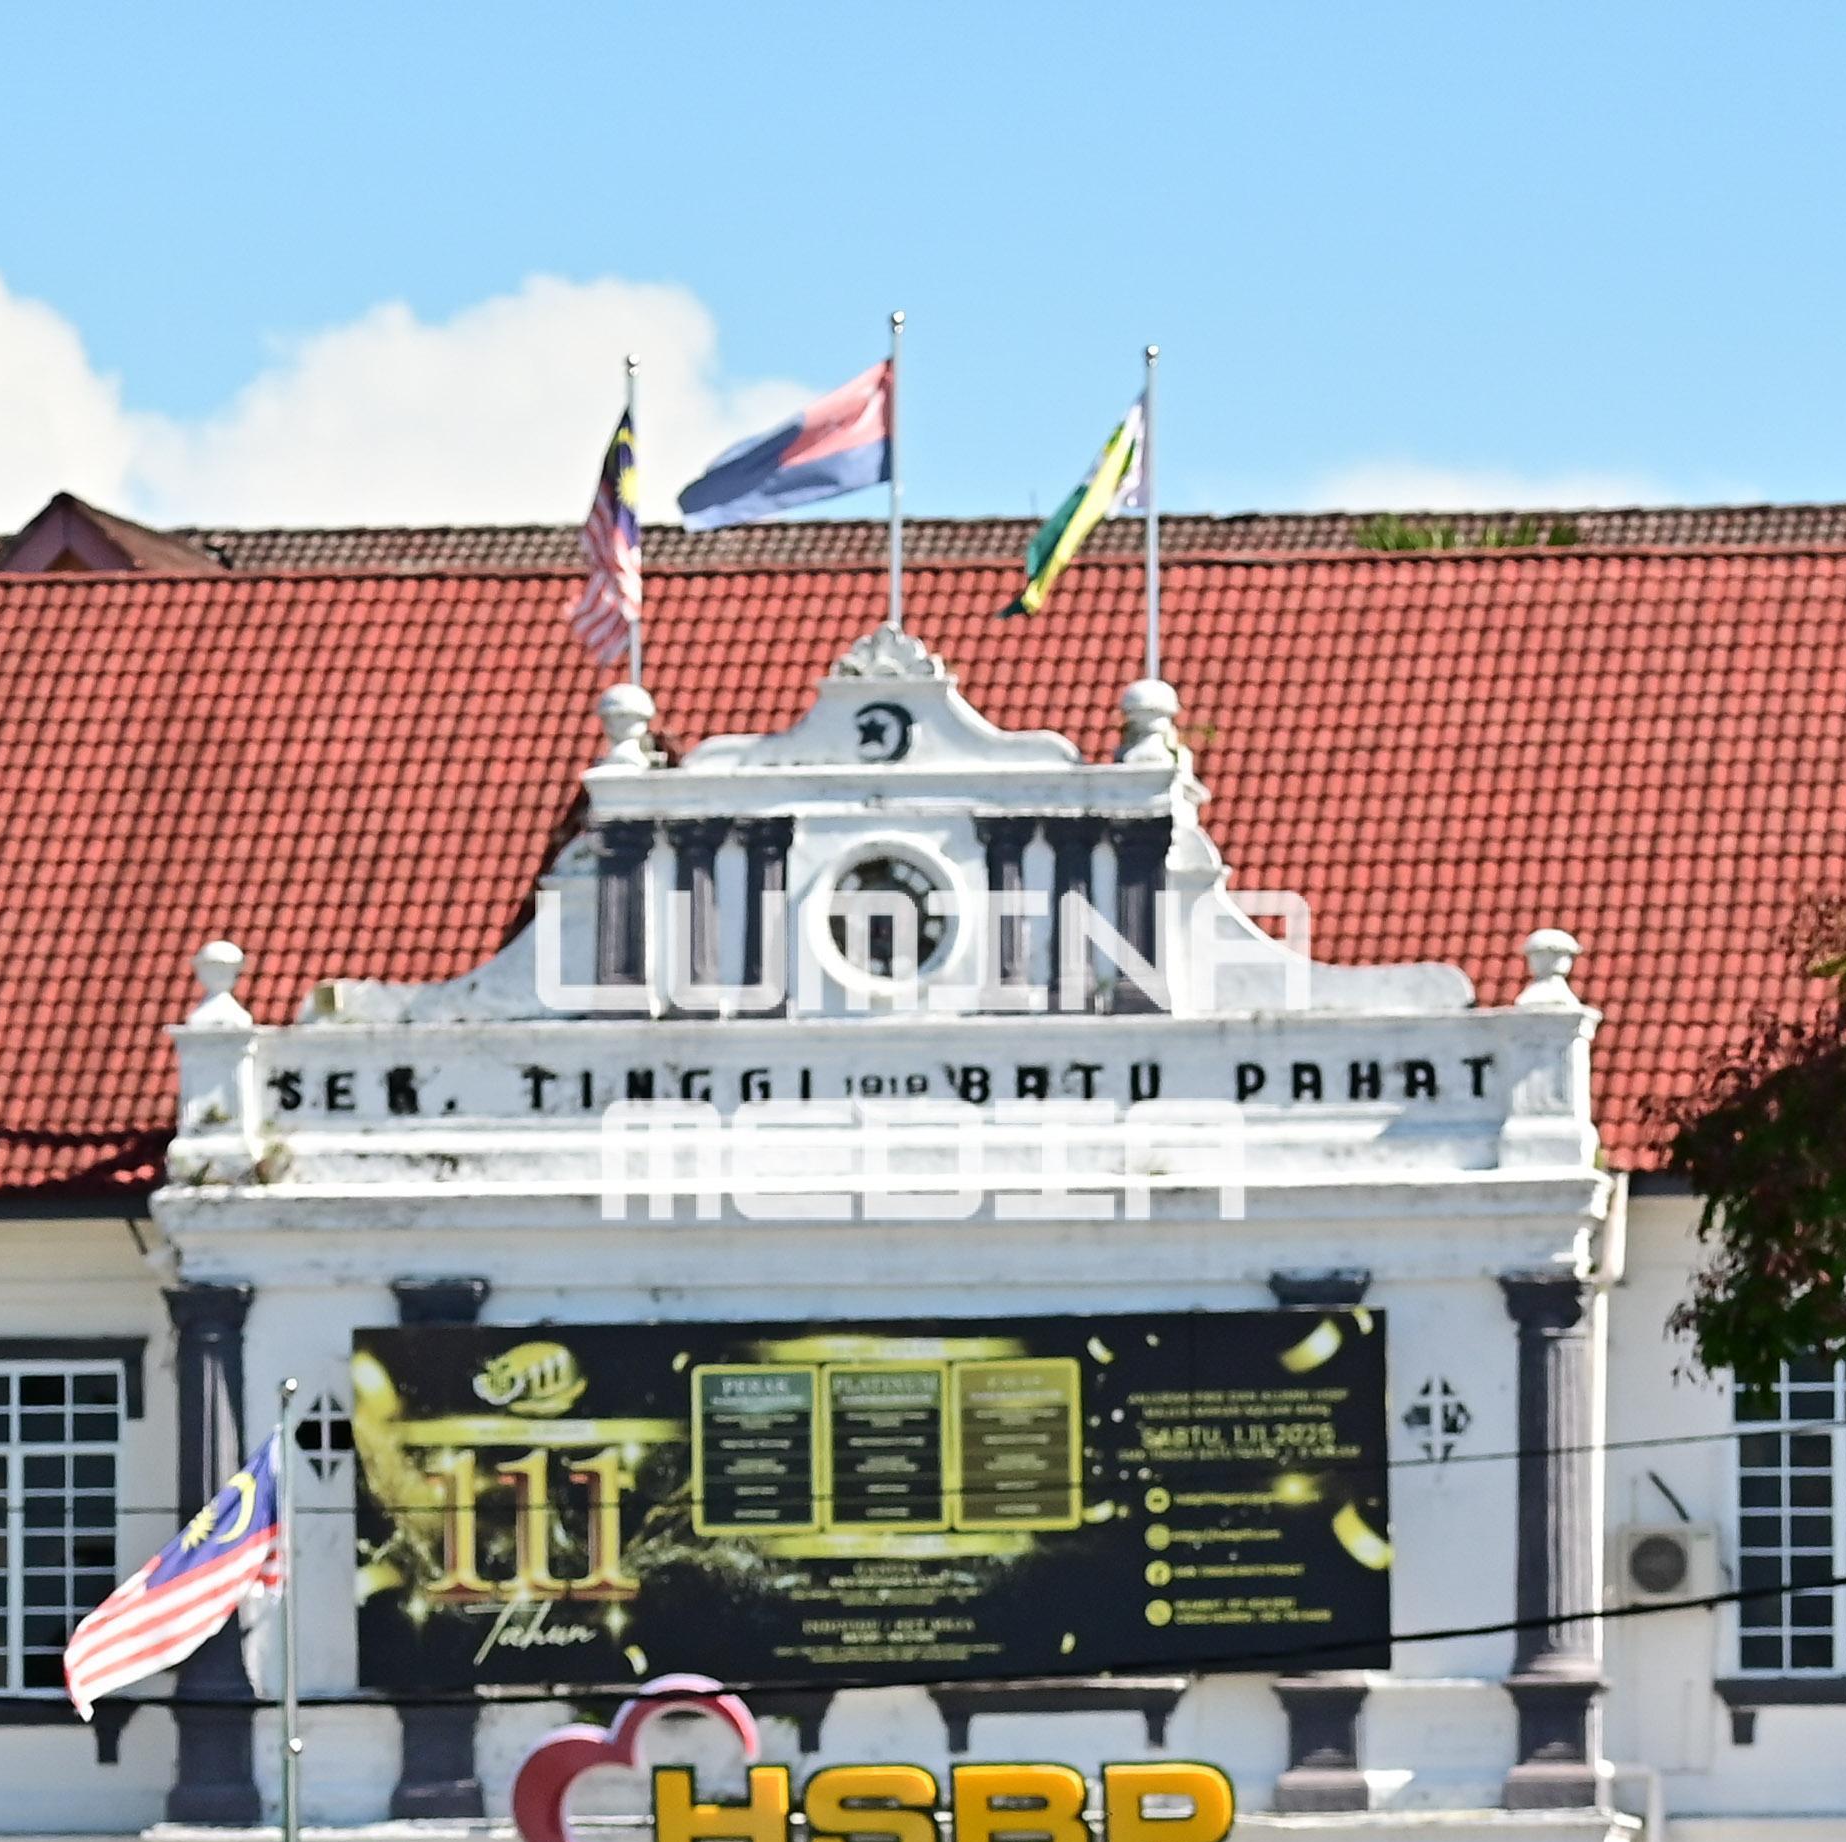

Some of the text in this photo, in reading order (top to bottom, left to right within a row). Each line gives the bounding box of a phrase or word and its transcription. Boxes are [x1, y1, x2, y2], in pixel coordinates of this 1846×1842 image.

[523, 1066, 814, 1110] TINGGI
[958, 1056, 1496, 1104] BATU PAHAT
[424, 1448, 641, 1600] 111
